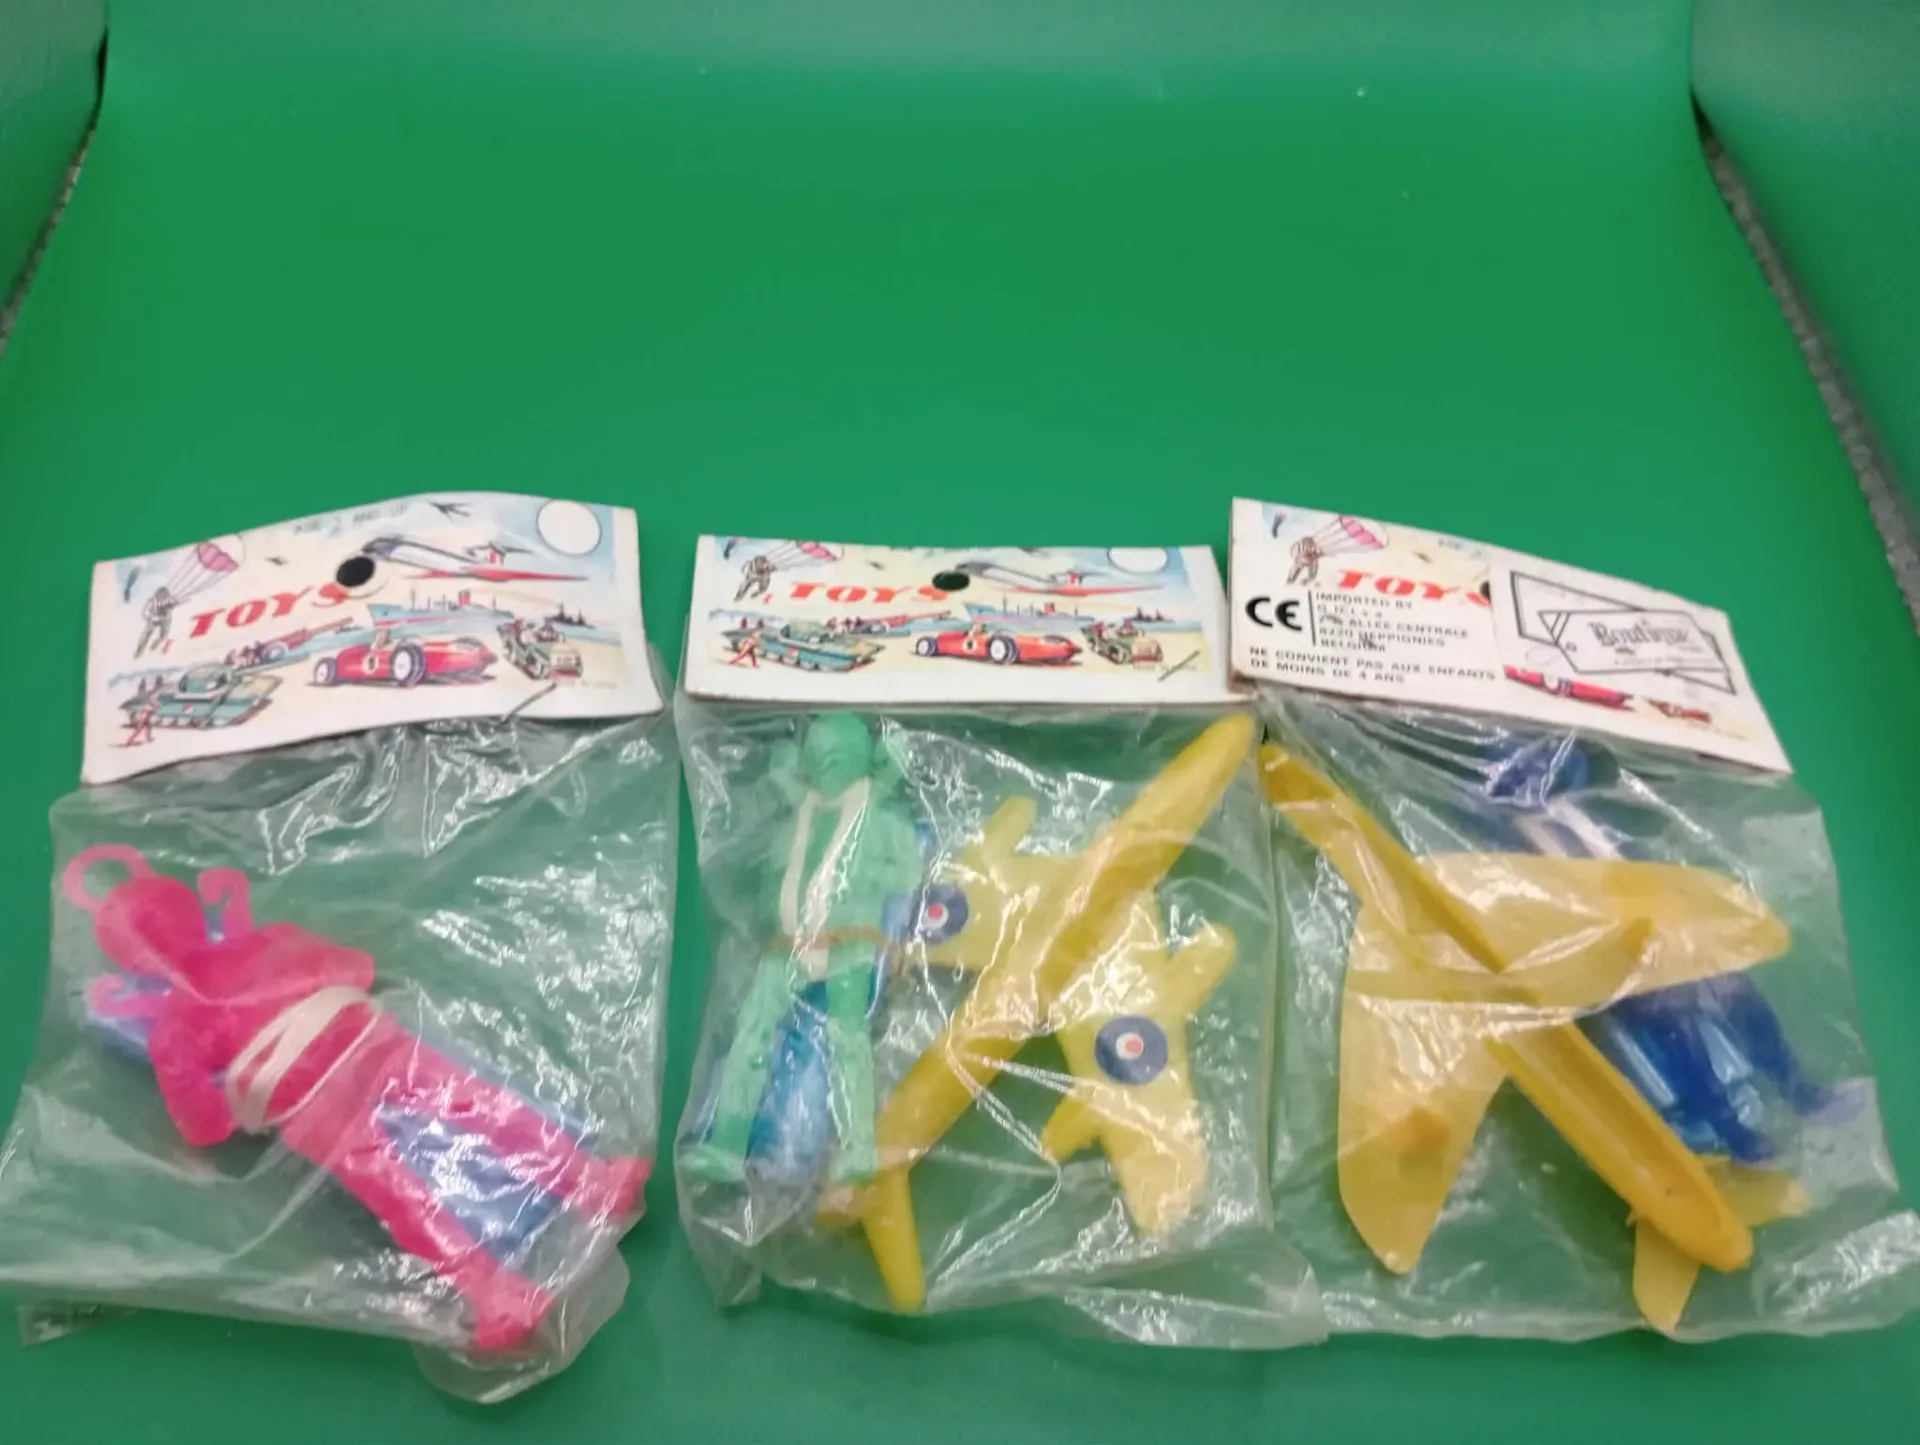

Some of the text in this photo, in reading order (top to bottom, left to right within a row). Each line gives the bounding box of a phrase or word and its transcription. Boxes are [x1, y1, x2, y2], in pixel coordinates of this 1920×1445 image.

[790, 582, 950, 604] TOYS
[1316, 591, 1413, 610] IMPORTED BY
[189, 581, 349, 638] TOYS
[1245, 596, 1302, 632] CE
[1349, 618, 1392, 631] ALLEE
[1396, 622, 1469, 639] CENTRALE
[1249, 646, 1496, 682] NE CONVIENT PAS AUX ENFANTS
[1250, 657, 1268, 669] DE
[1276, 661, 1326, 676] MOINS
[1332, 669, 1351, 679] DE
[1373, 672, 1404, 685] ANS
